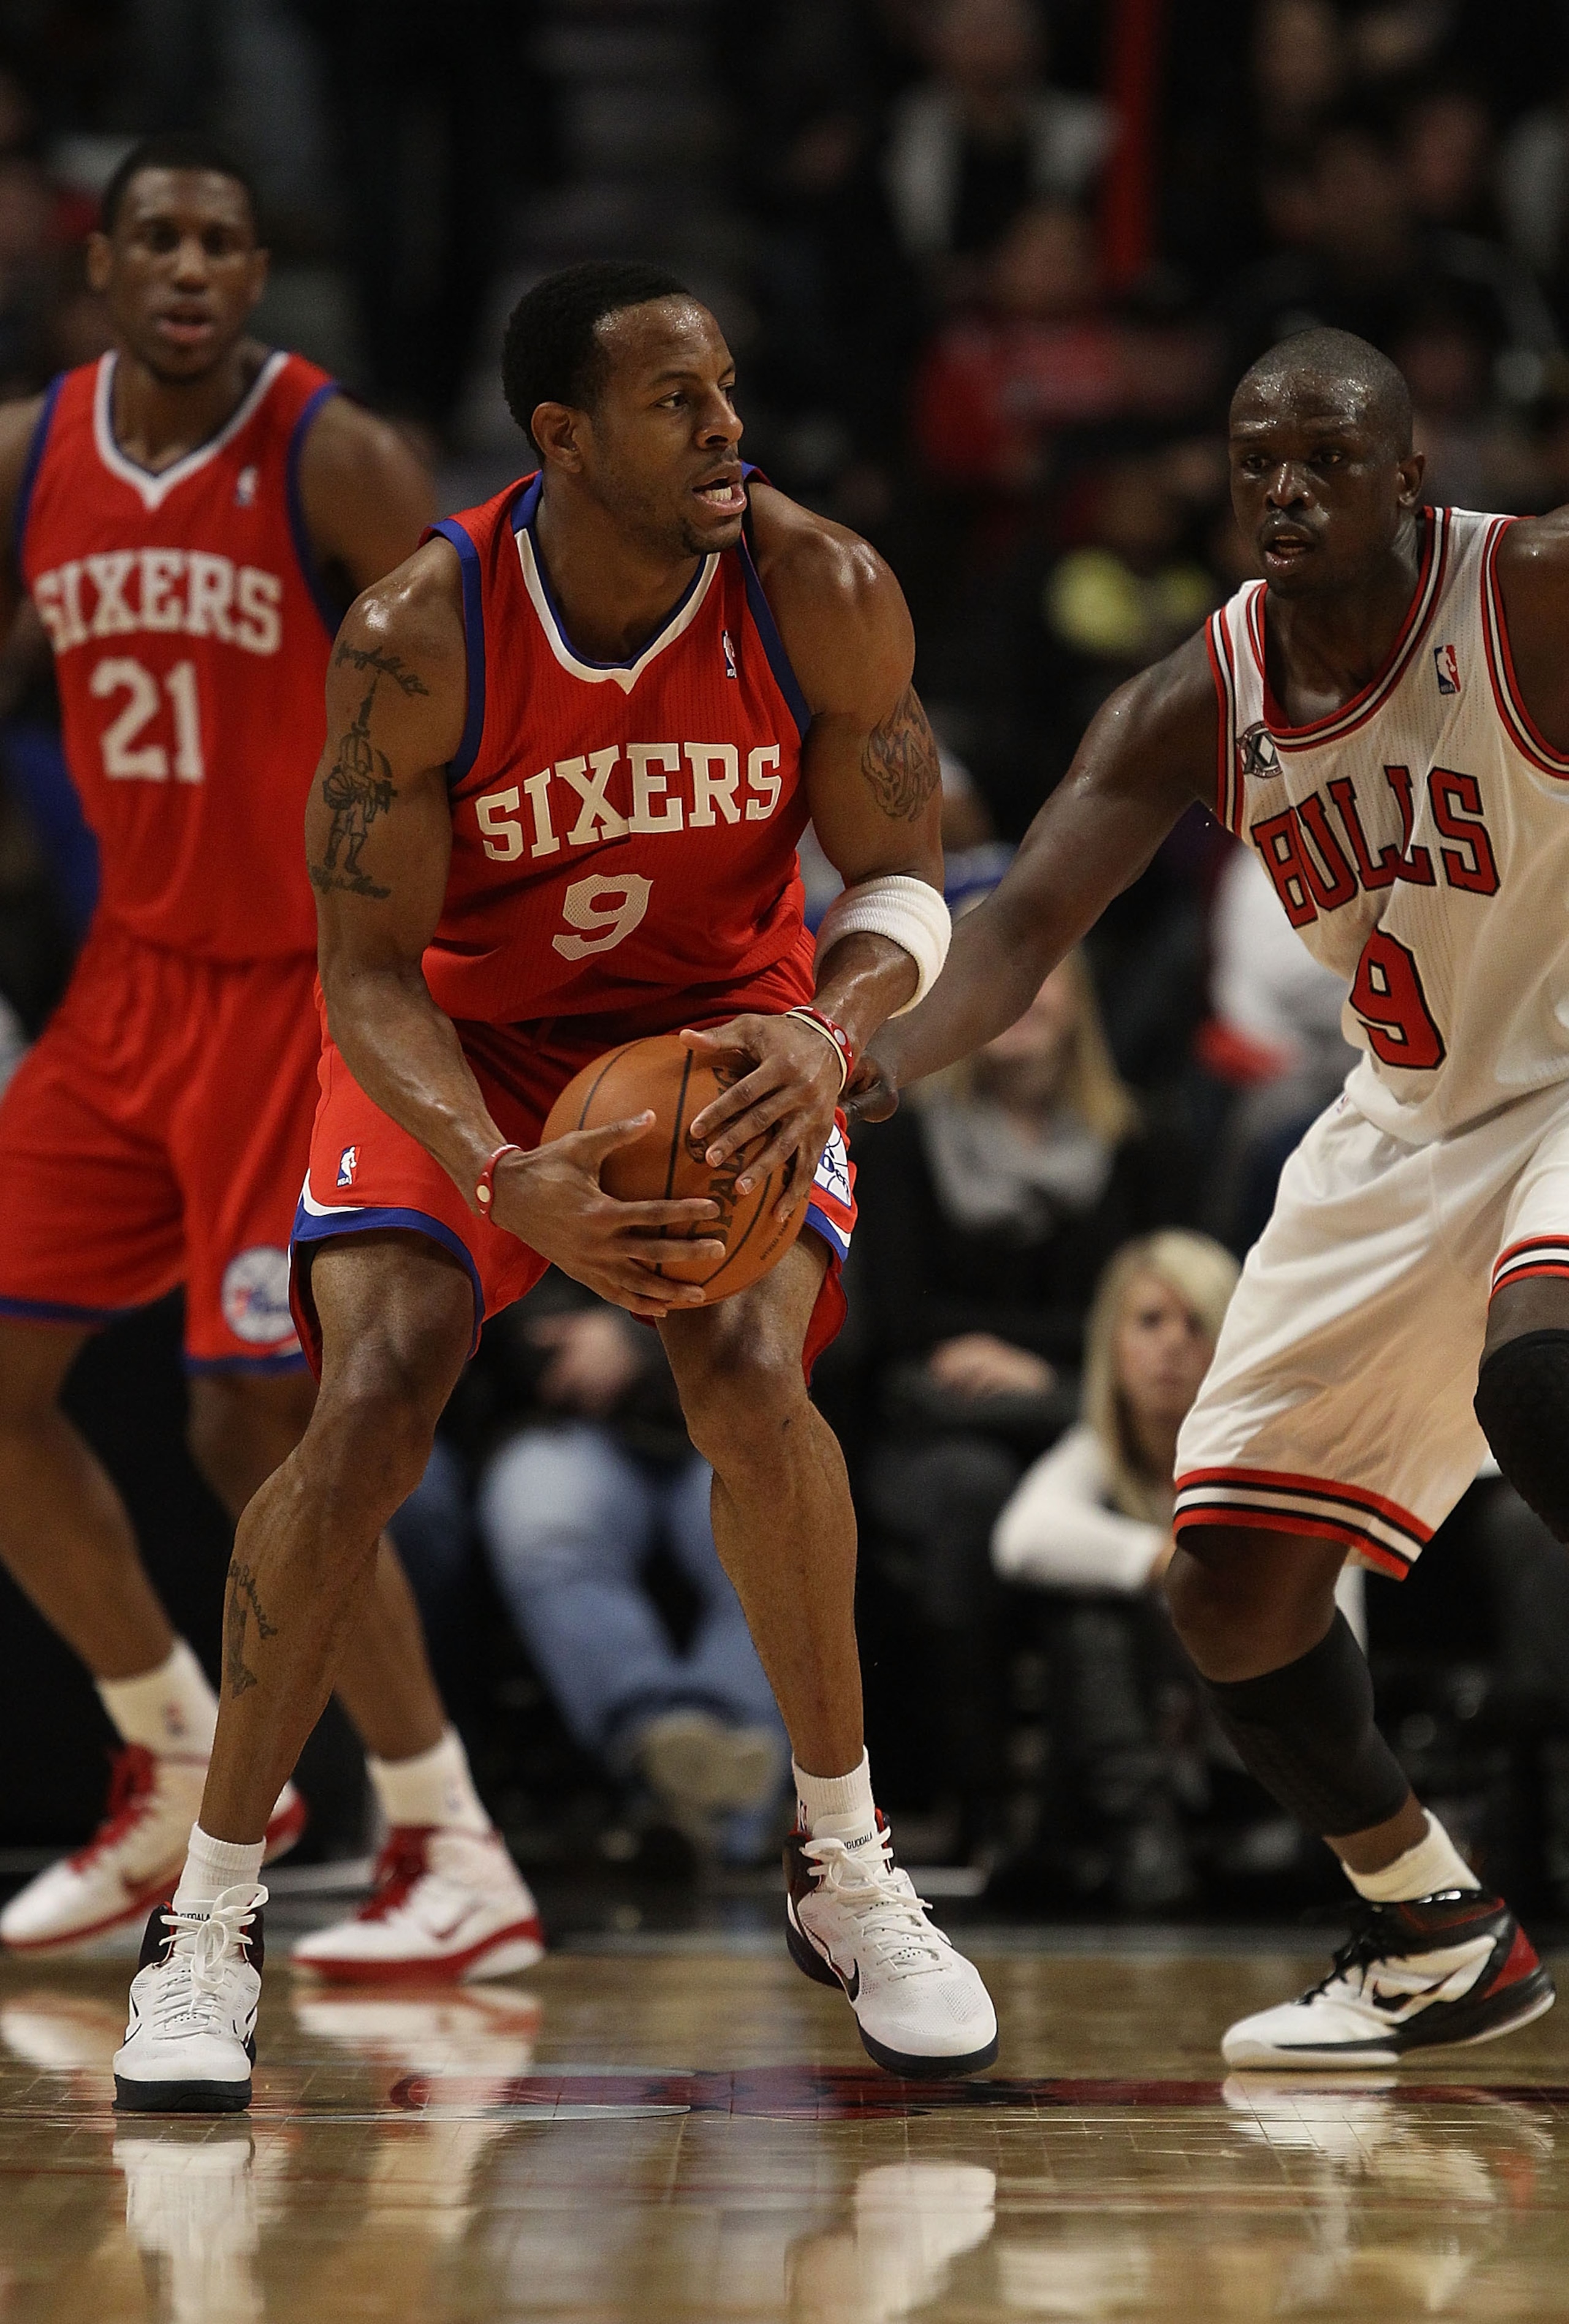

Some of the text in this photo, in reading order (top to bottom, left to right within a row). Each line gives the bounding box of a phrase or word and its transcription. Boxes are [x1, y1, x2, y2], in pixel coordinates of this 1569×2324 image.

[33, 546, 282, 657] SIXERS
[88, 655, 205, 785] 21
[474, 742, 783, 862] SIXERS
[1250, 766, 1500, 928] BULLS
[552, 873, 655, 961] 9
[1349, 923, 1447, 1070] 9
